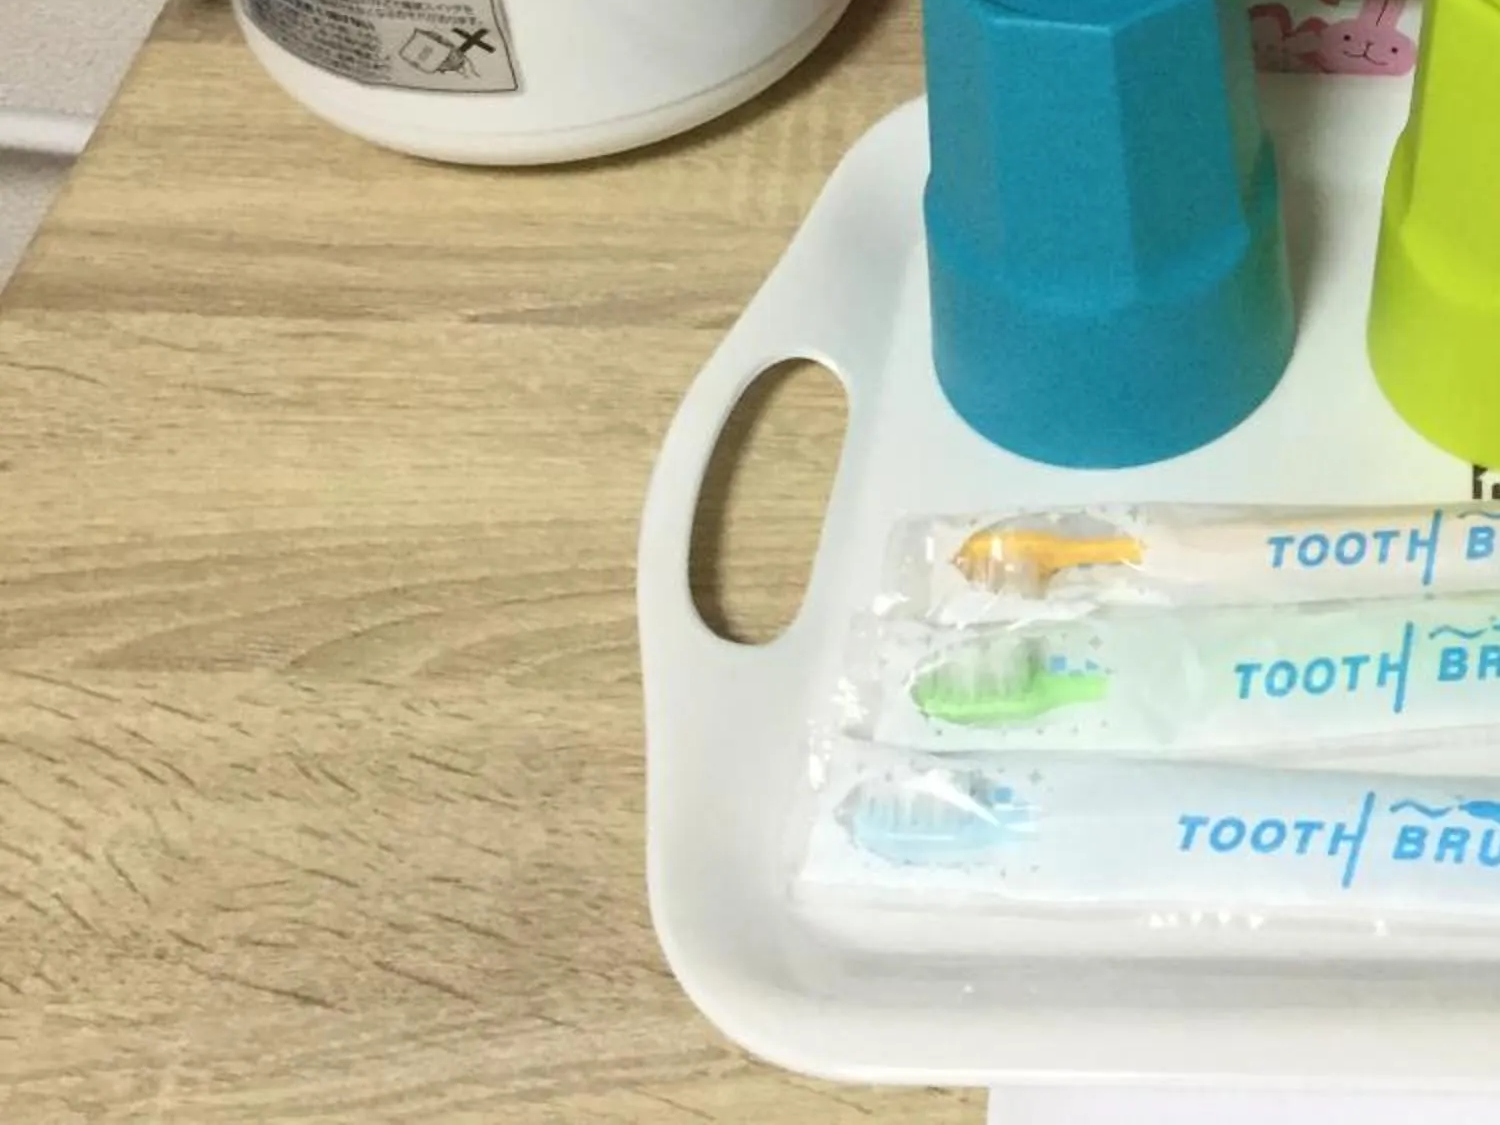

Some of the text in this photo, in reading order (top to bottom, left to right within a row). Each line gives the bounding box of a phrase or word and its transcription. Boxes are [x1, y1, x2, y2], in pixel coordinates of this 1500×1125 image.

[1266, 508, 1443, 586] TOOTH
[1233, 620, 1415, 714] TOOTH
[1177, 790, 1377, 889] TOOTH
